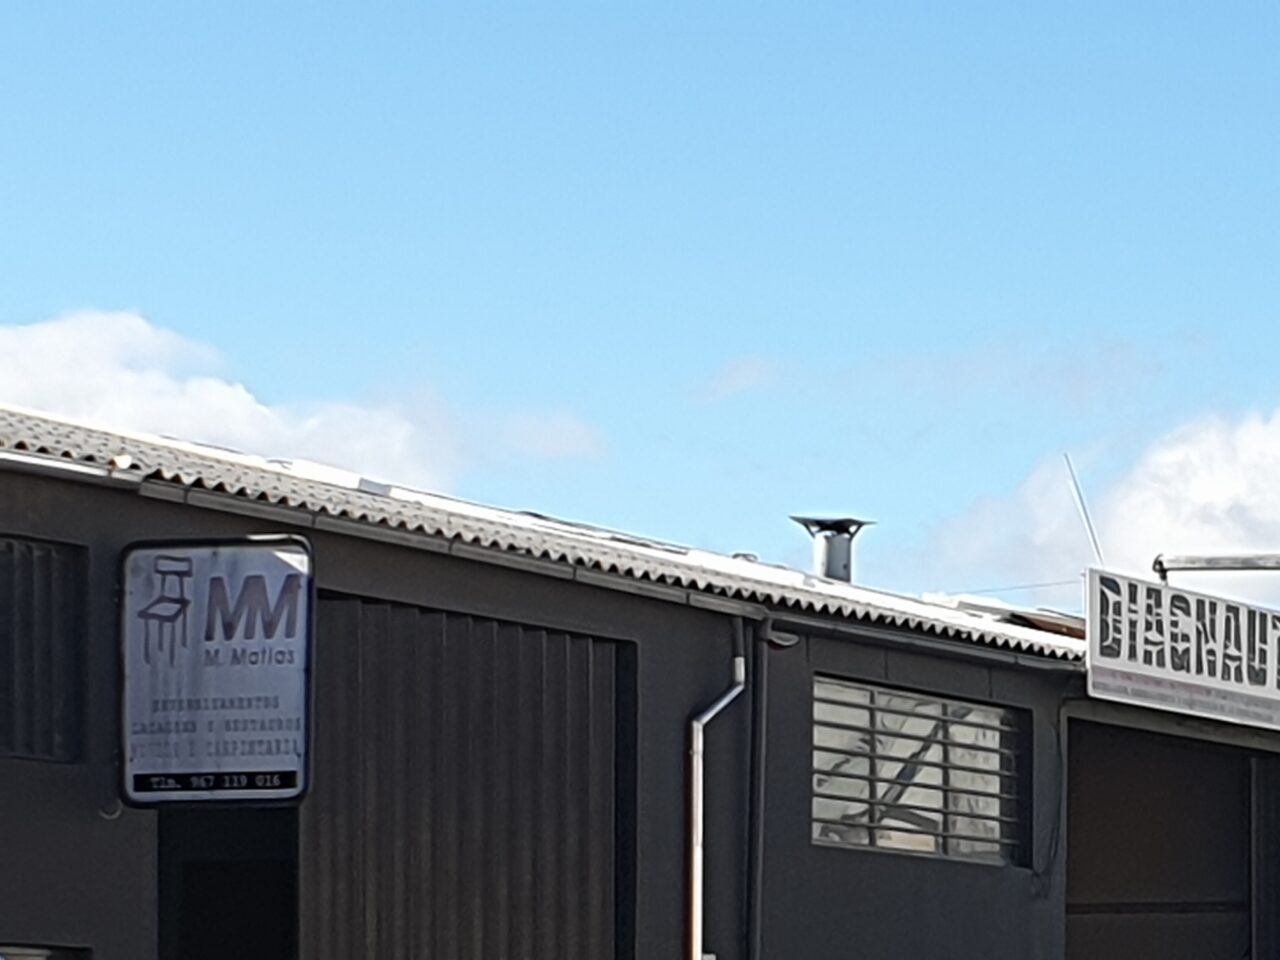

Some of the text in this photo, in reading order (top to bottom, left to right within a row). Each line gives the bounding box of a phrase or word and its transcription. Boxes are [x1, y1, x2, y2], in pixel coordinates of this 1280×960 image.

[204, 574, 300, 641] MM
[230, 648, 295, 665] Matias
[255, 774, 281, 787] 016
